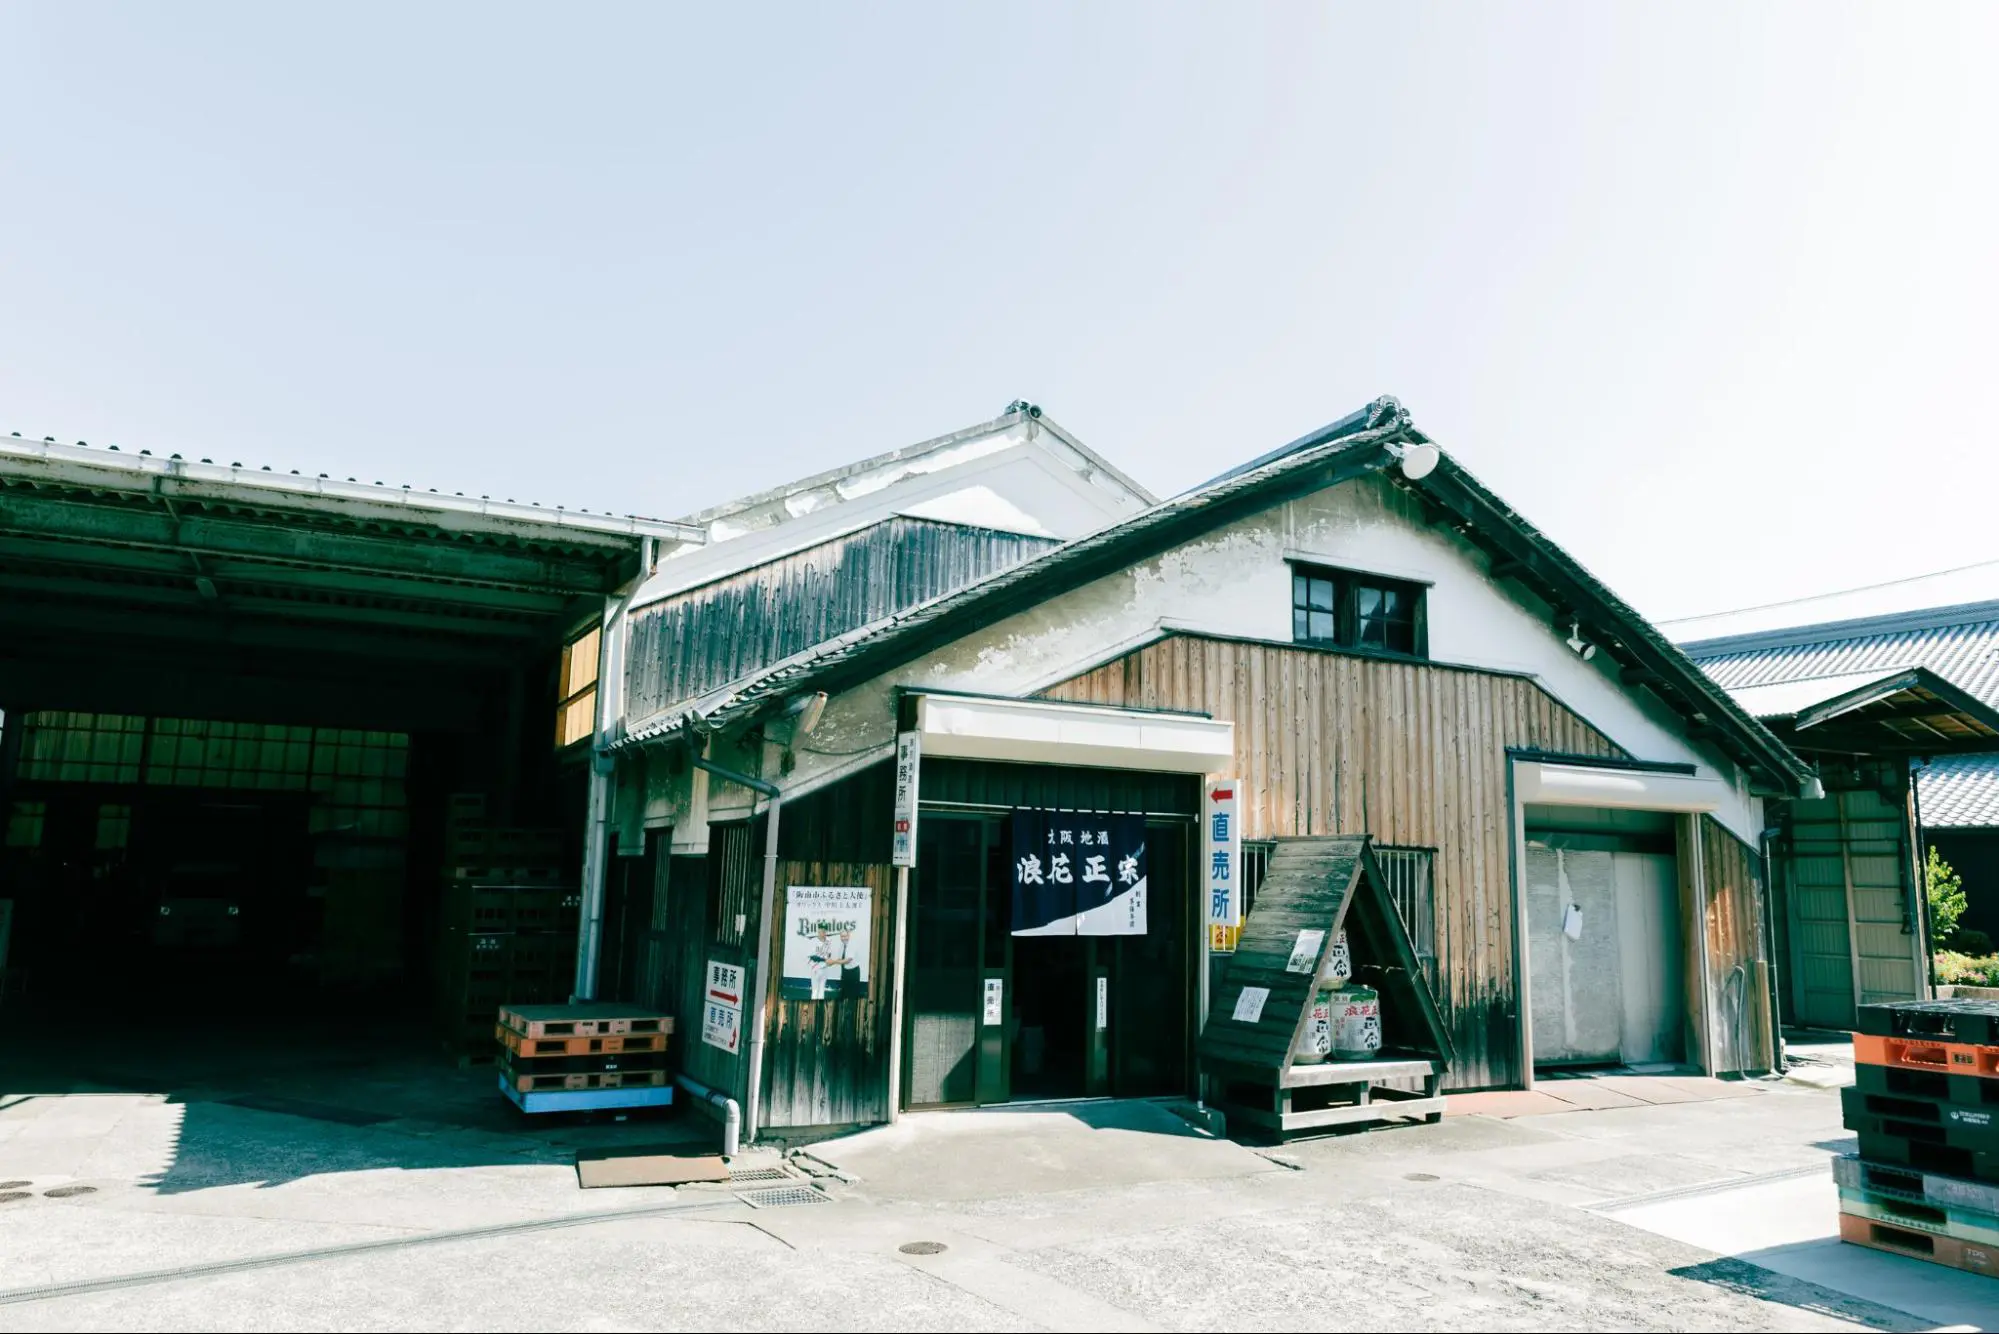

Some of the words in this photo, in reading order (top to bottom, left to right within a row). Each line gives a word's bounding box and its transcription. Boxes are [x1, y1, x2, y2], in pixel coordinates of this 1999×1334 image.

[899, 744, 908, 802] 事務所
[1048, 829, 1109, 845] 大阪地酒
[1016, 852, 1139, 885] 浪花正宗
[1211, 812, 1230, 919] 直売所
[713, 966, 737, 989] 事務所
[709, 1007, 734, 1029] 直売所
